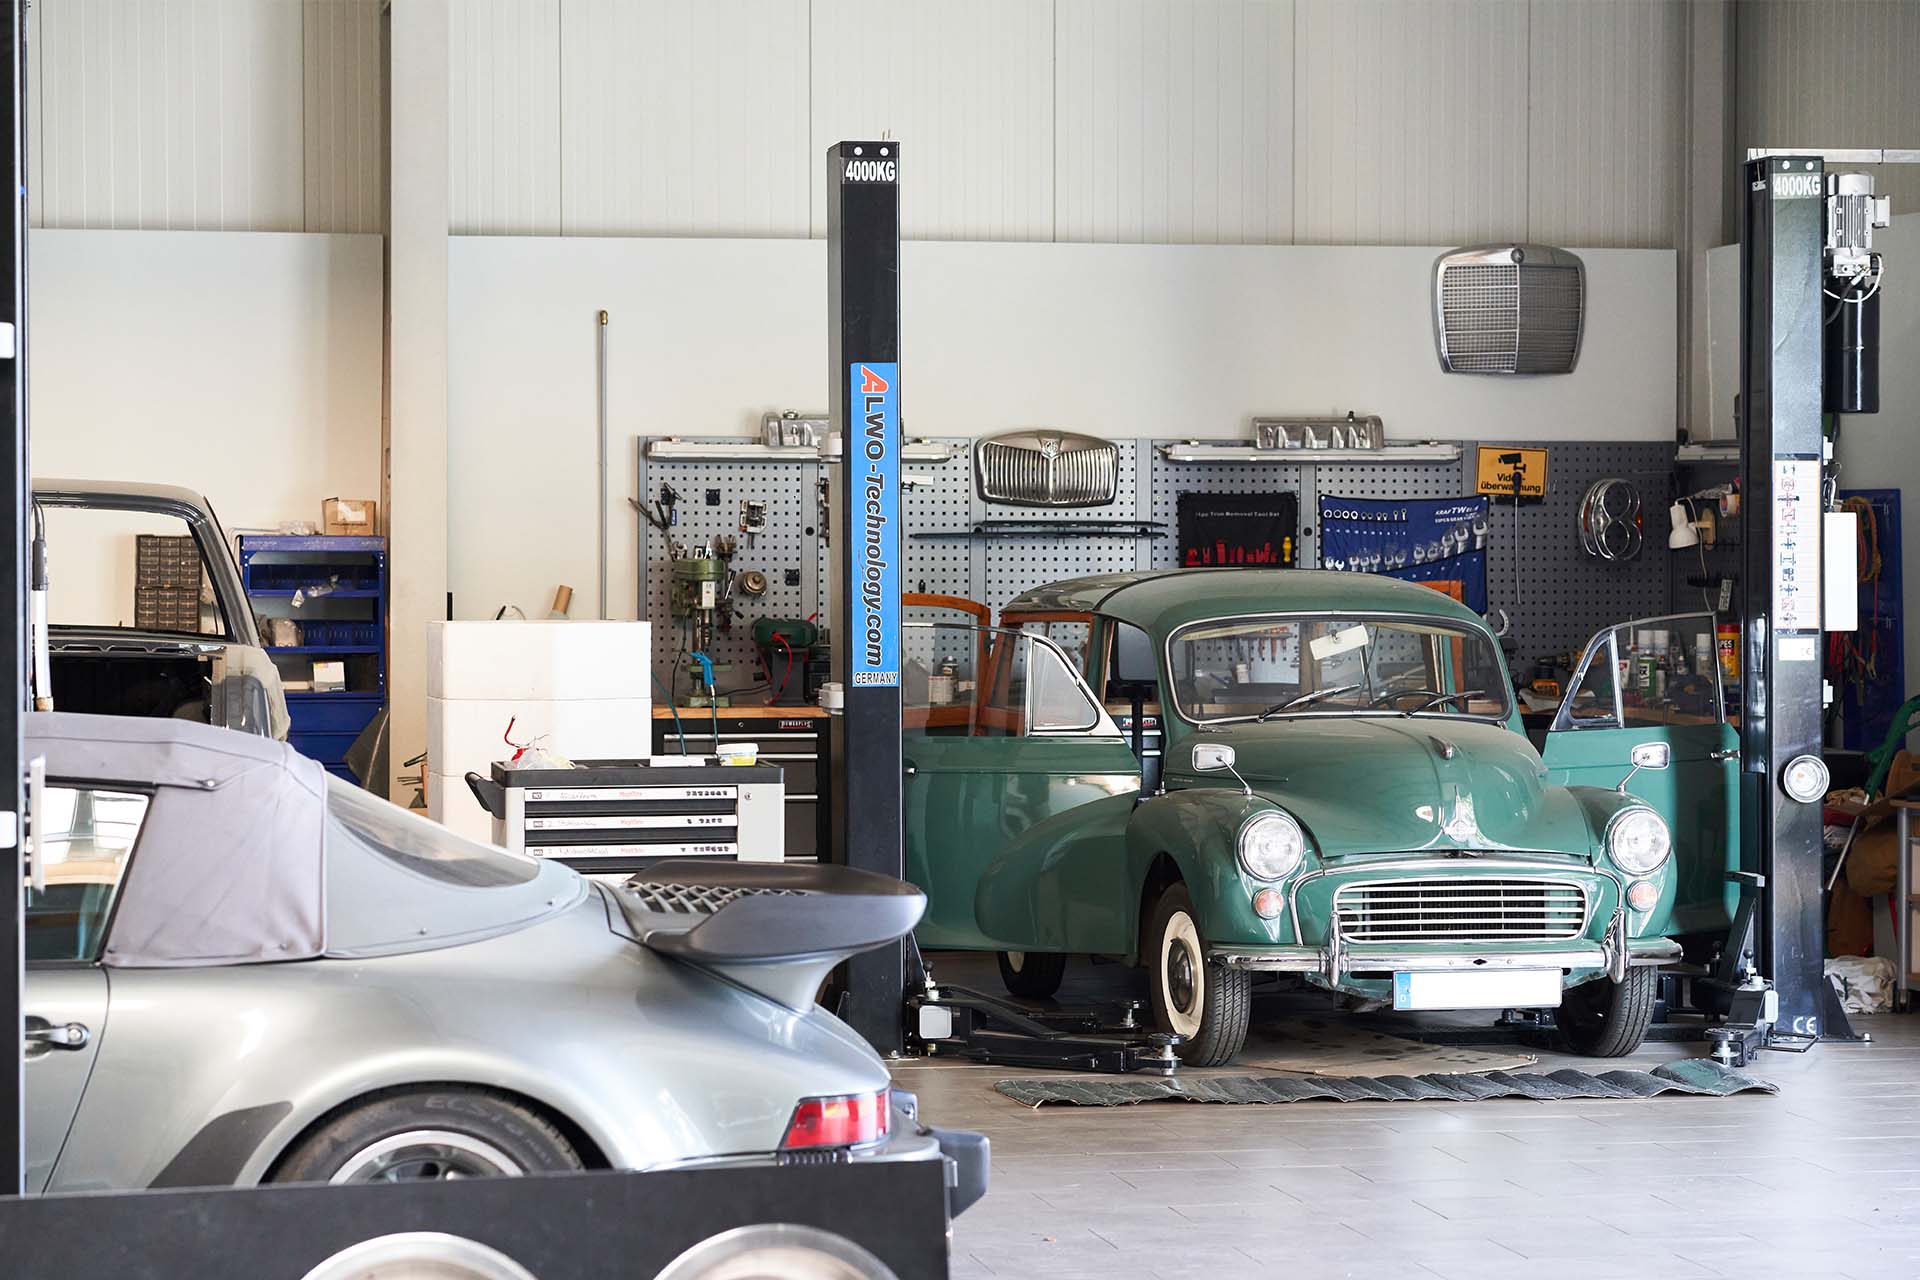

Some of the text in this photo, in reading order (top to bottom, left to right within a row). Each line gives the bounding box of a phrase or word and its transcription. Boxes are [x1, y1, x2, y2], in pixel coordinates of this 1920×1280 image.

[845, 160, 896, 182] 4000KG
[1773, 174, 1821, 196] 4000KG
[854, 671, 898, 685] GERMANY
[1793, 1016, 1817, 1034] CE
